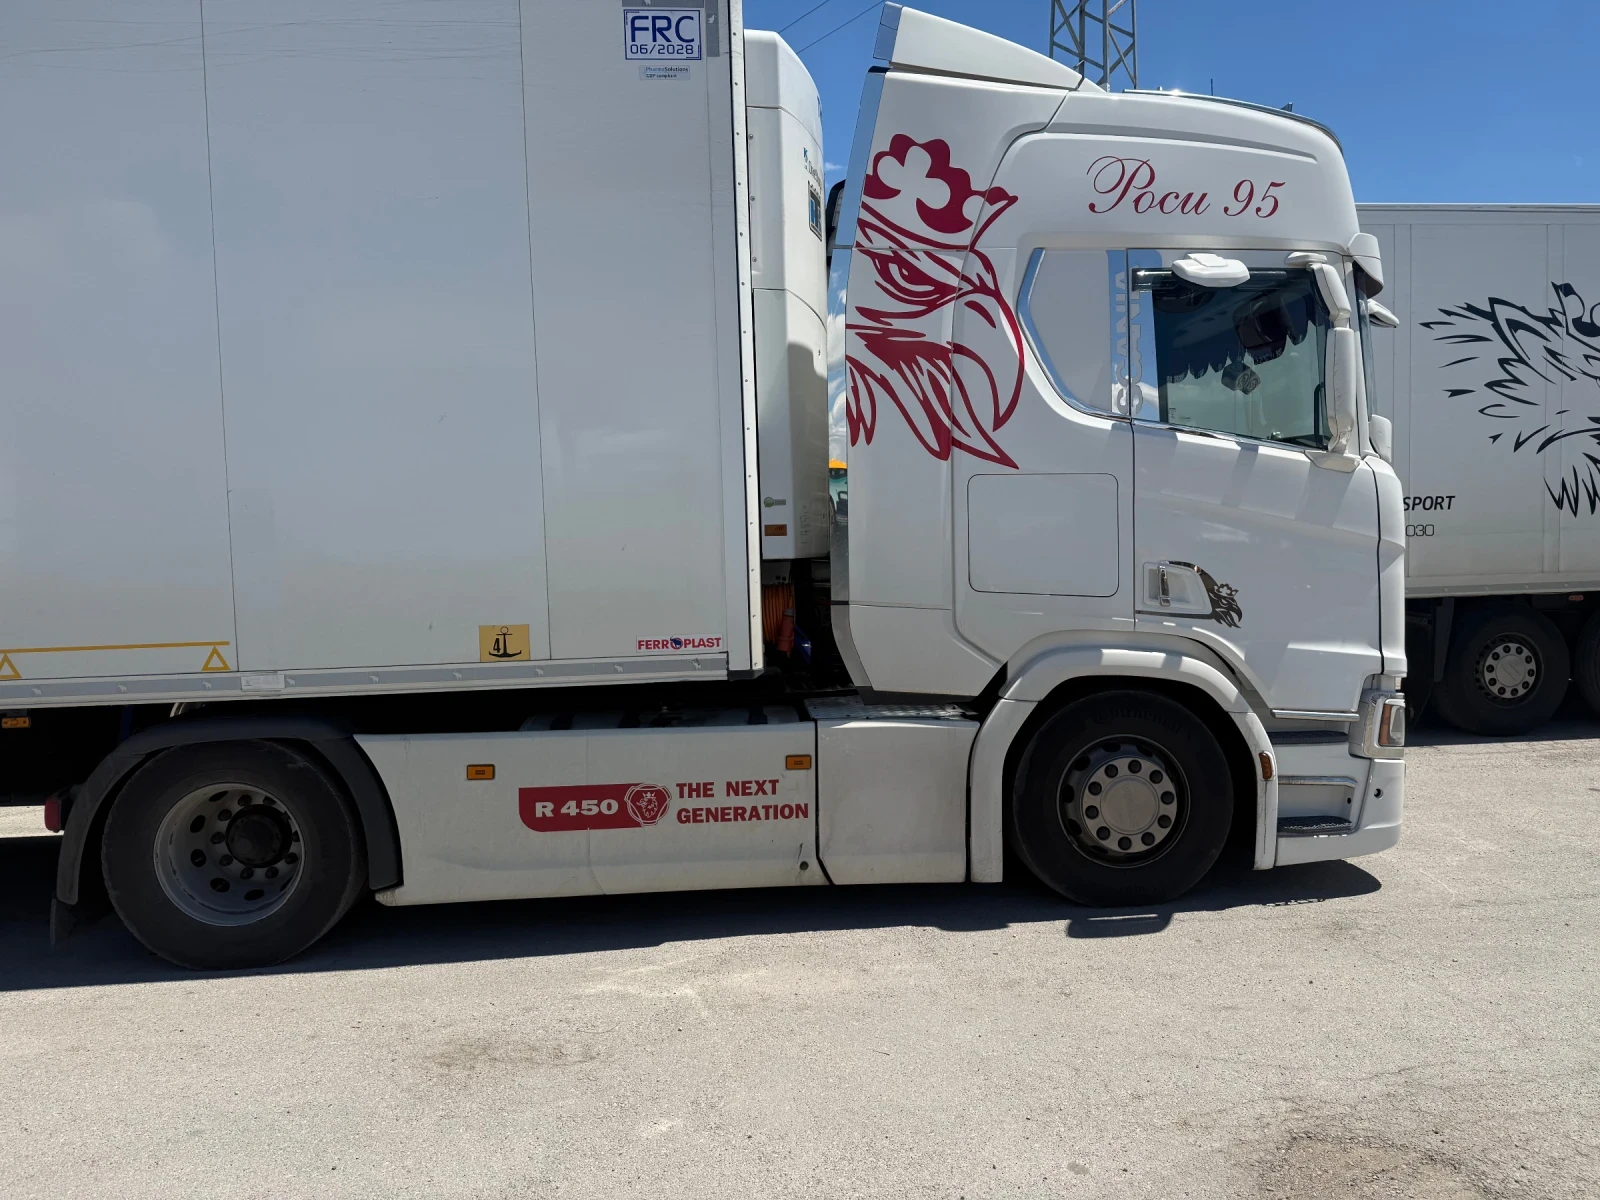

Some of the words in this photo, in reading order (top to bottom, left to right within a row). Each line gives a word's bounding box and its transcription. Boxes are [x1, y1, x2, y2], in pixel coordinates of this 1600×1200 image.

[630, 15, 695, 43] FRC
[630, 44, 694, 55] 06/2028
[1223, 179, 1286, 219] 95
[676, 782, 715, 799] THE
[726, 779, 780, 797] NEXT
[535, 801, 555, 818] R
[560, 799, 619, 817] 450
[676, 803, 809, 824] GENERATION
